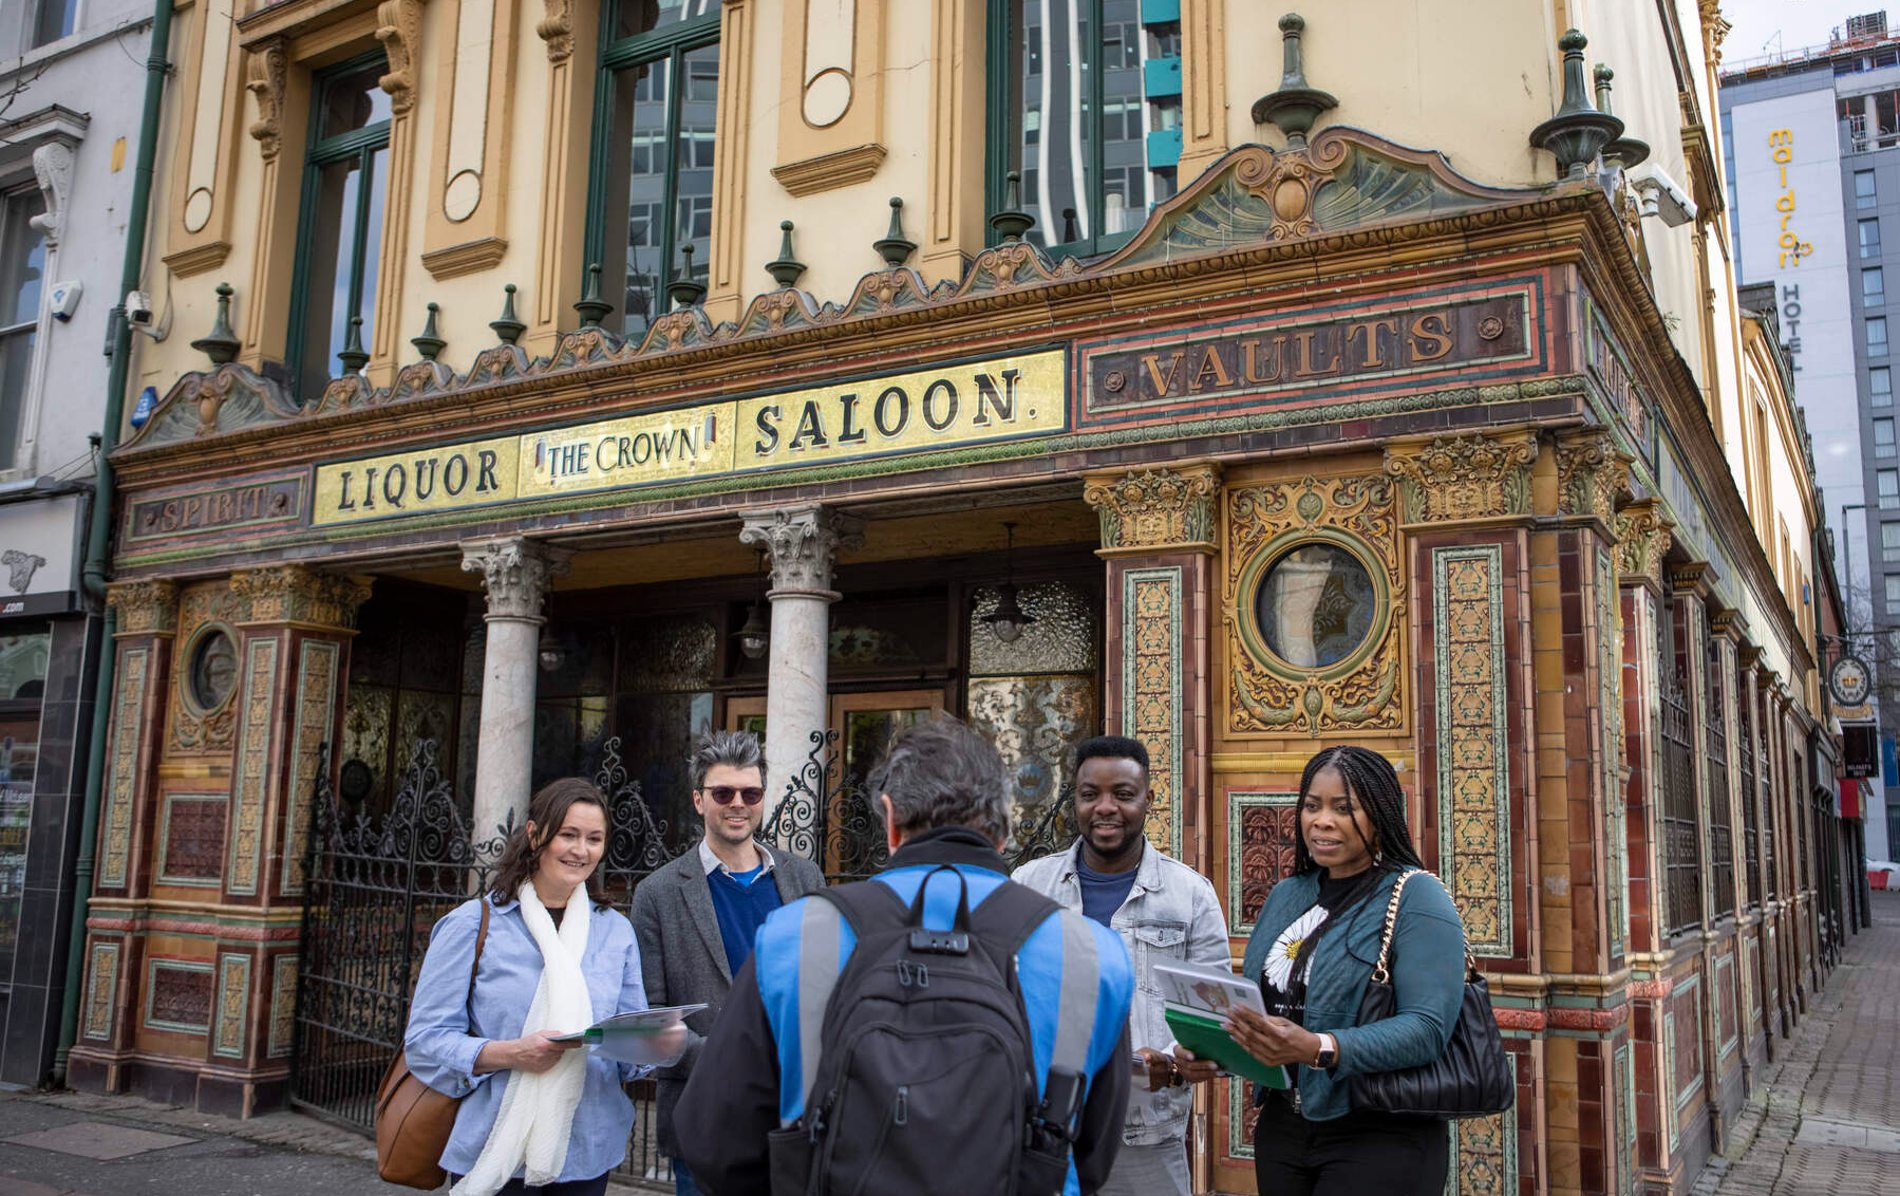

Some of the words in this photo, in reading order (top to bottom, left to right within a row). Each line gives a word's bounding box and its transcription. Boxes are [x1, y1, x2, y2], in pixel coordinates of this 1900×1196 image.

[1768, 128, 1799, 270] maldron
[1141, 312, 1454, 397] VAULTS
[1783, 283, 1804, 372] HOTEL
[337, 449, 499, 511] LIQUOR
[547, 442, 591, 478] THE
[595, 425, 701, 473] CROWN
[160, 487, 267, 533] SPIRIT
